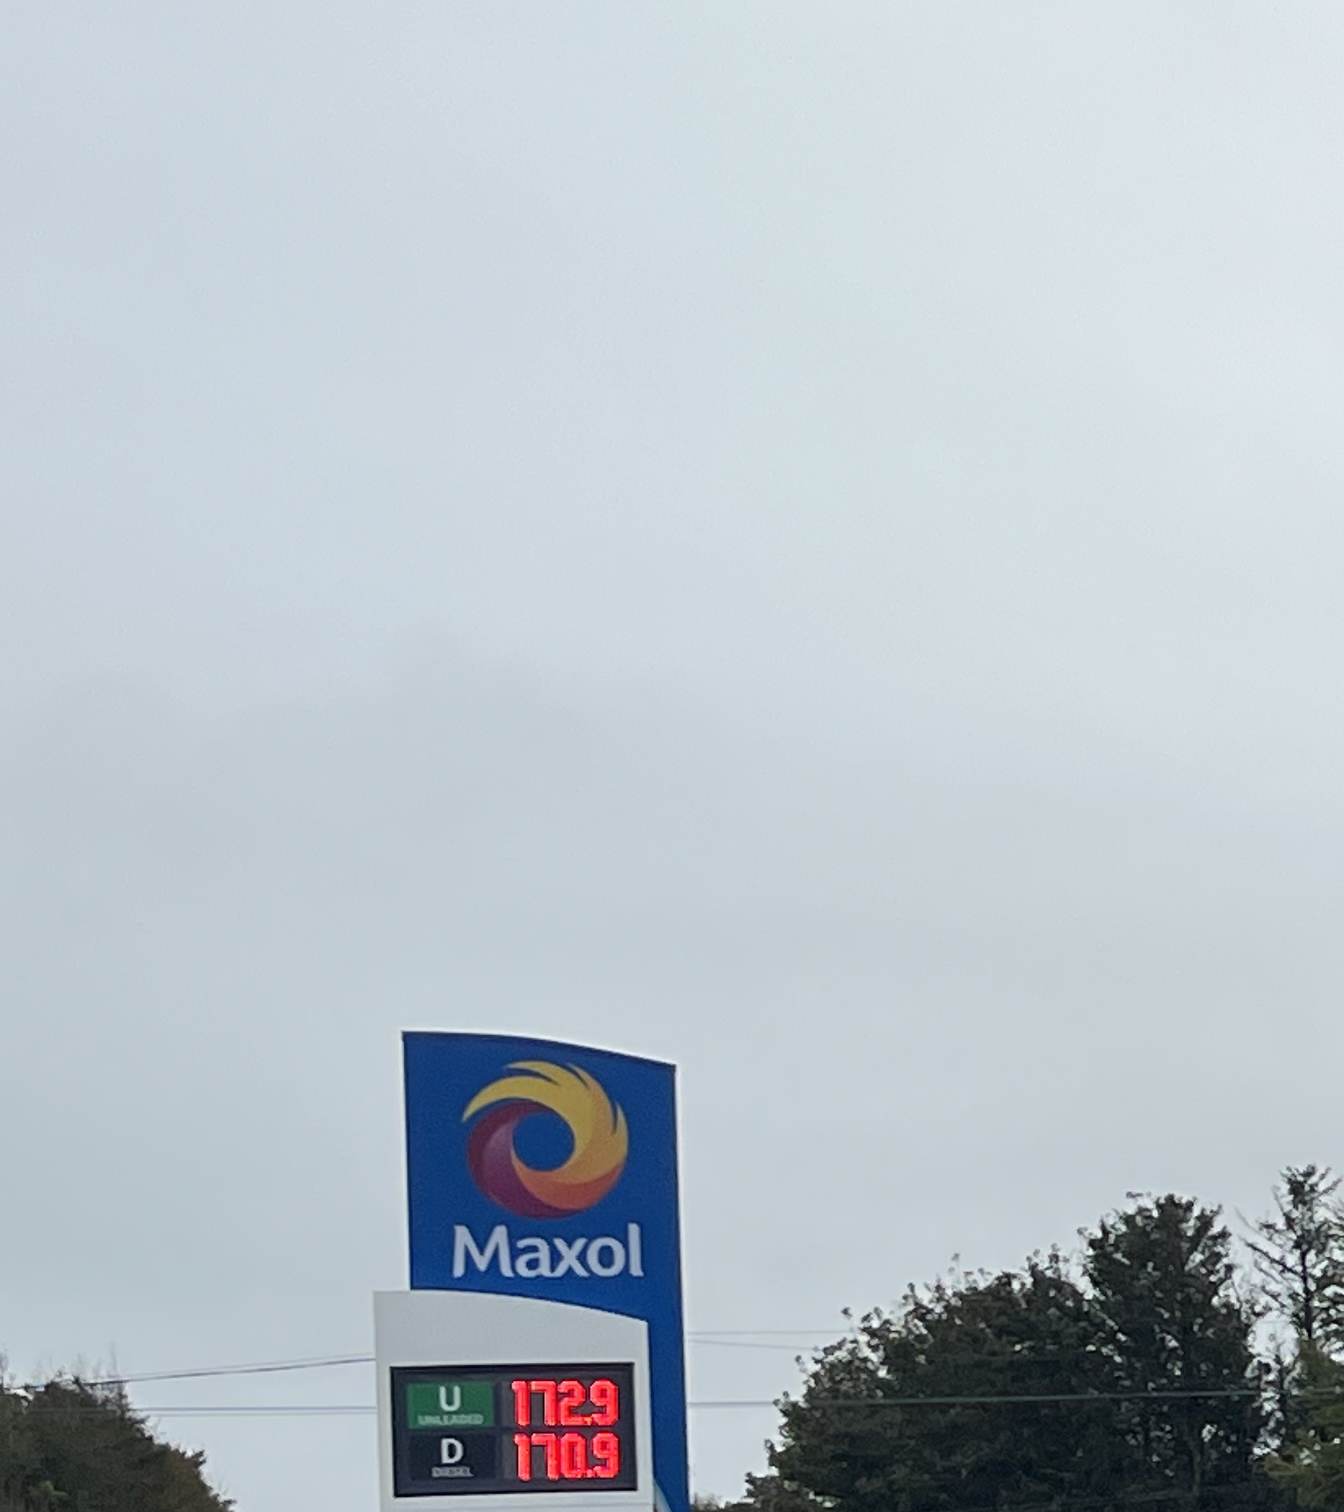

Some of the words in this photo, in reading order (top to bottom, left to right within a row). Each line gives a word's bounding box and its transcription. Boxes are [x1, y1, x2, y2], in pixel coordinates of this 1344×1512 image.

[451, 1222, 644, 1279] Maxol
[438, 1385, 462, 1411] U
[511, 1379, 619, 1427] 172.9
[441, 1438, 464, 1464] D
[514, 1432, 620, 1481] 170.9
